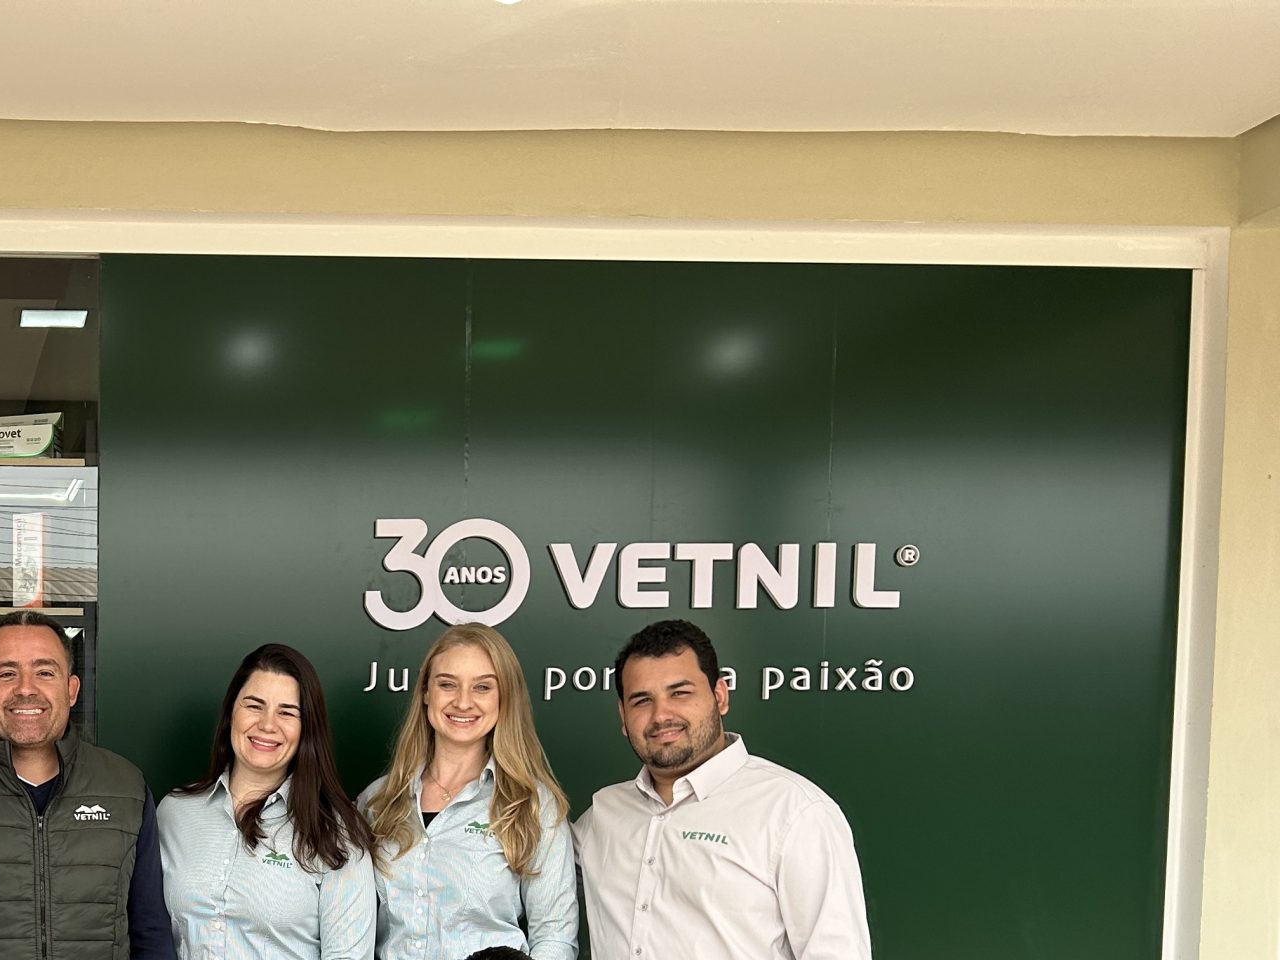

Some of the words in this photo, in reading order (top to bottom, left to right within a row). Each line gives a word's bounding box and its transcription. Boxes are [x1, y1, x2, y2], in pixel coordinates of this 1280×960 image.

[444, 566, 506, 584] ANOS
[762, 659, 915, 700] paixão
[682, 831, 728, 845] VETNIL
[261, 858, 293, 868] VETNIL
